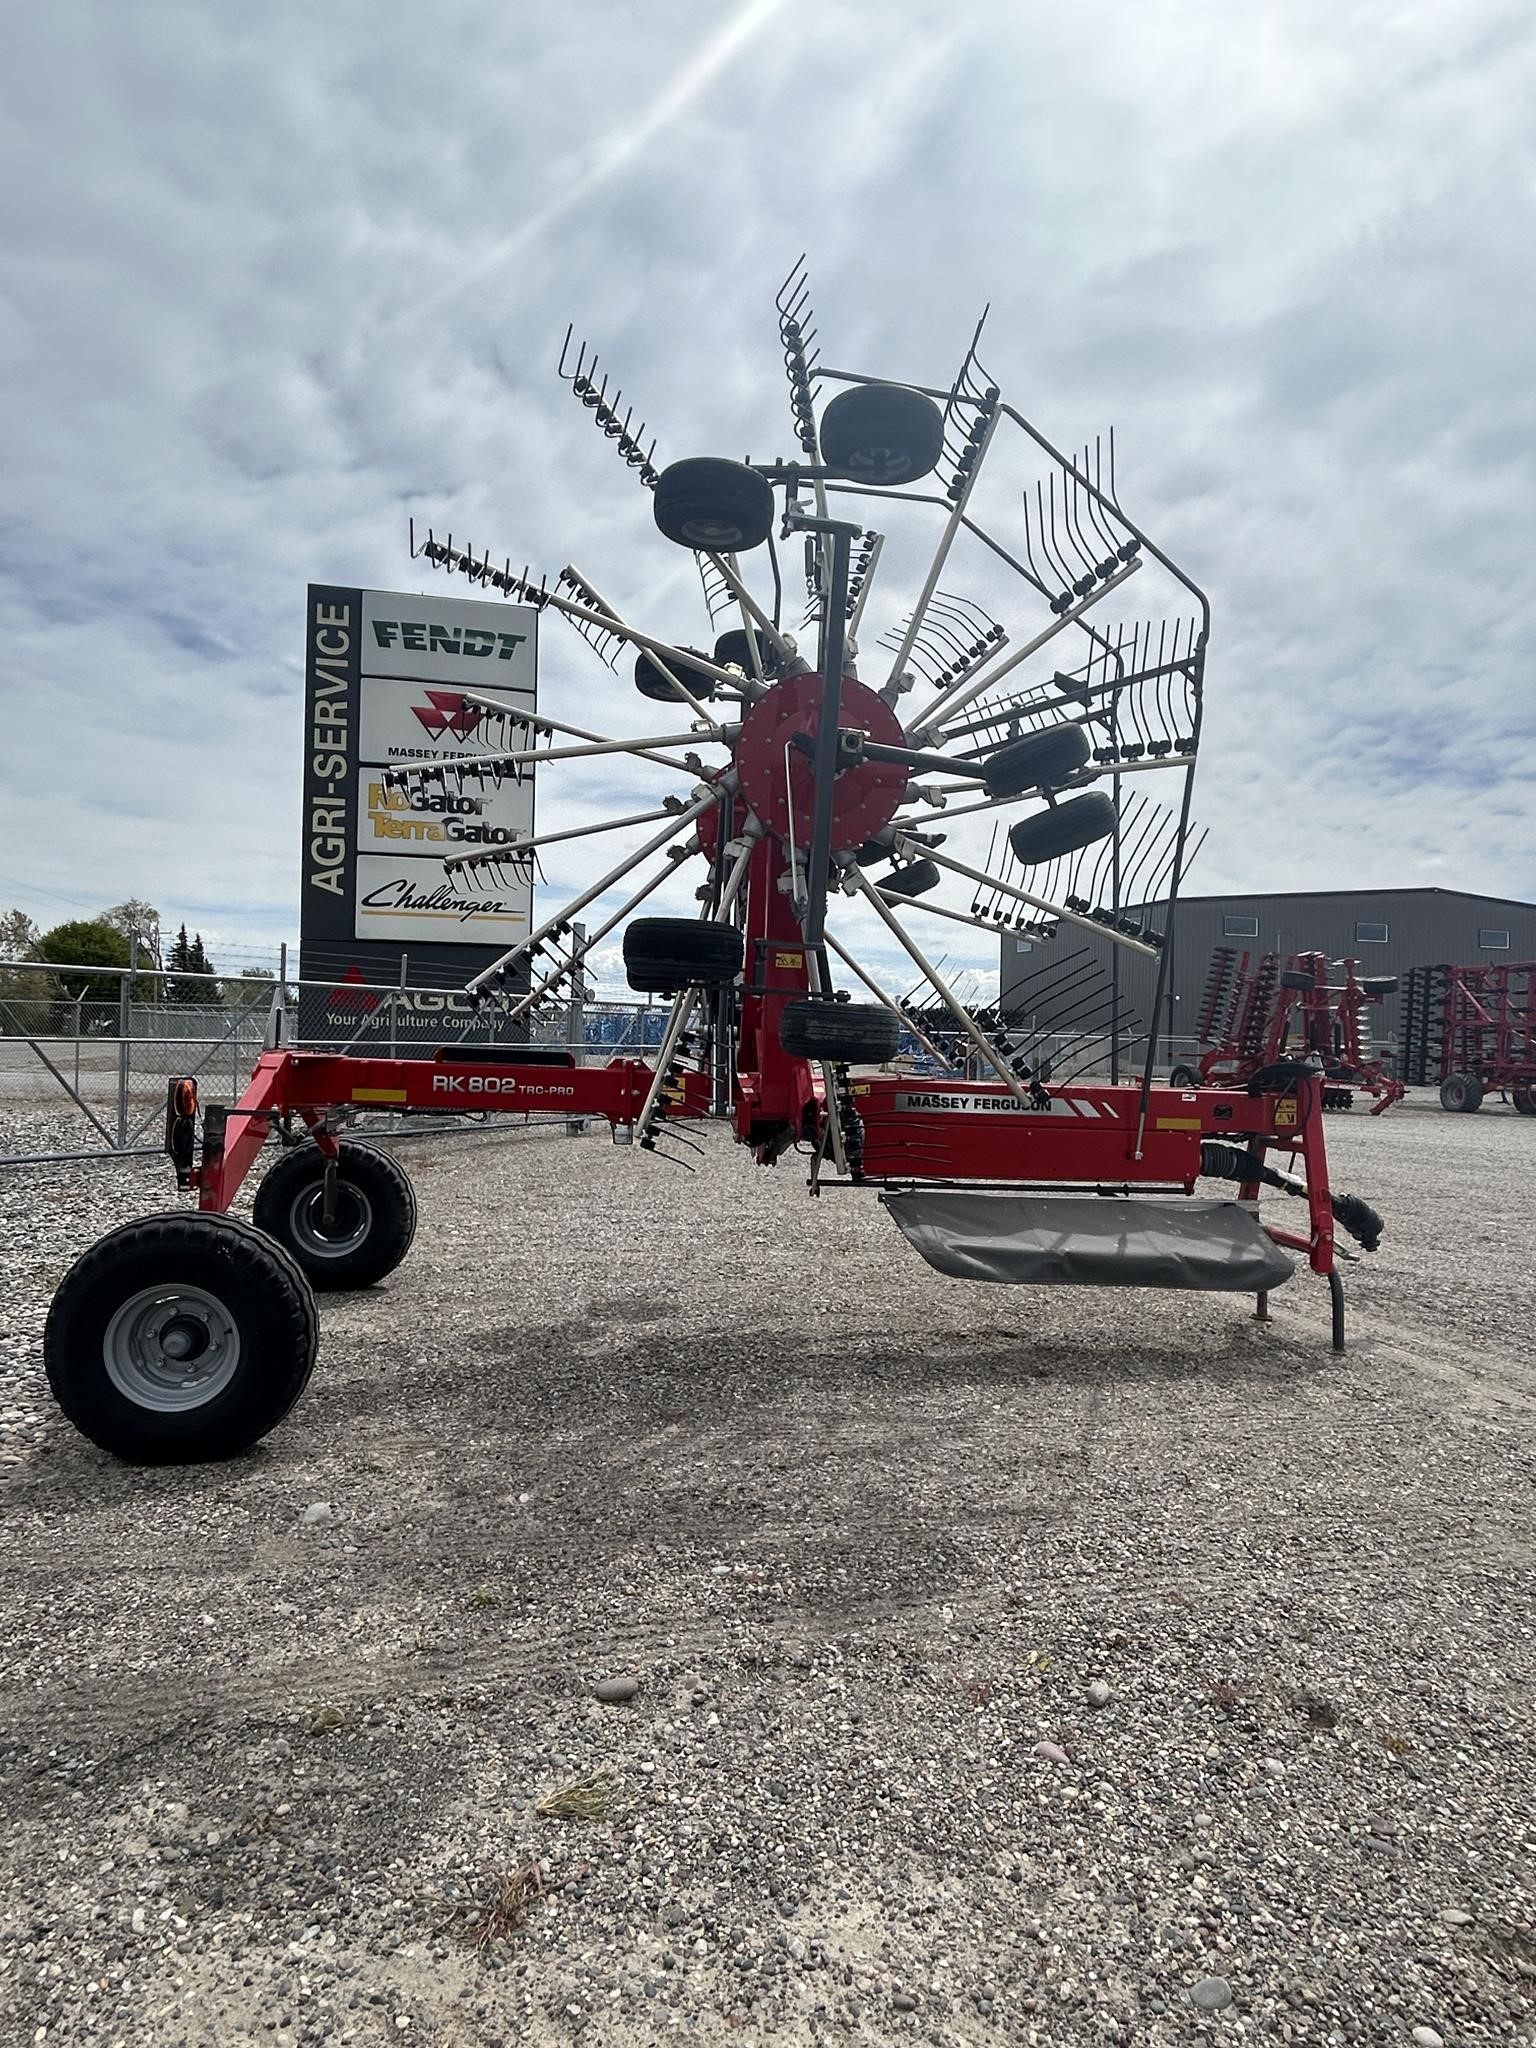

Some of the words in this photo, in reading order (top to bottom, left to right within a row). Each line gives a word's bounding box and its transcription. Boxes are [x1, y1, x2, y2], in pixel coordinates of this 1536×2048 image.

[371, 620, 527, 661] FENDT
[310, 603, 350, 896] AGRI-SERVICE
[387, 747, 439, 759] MASSEY
[368, 783, 489, 815] RoGator
[368, 811, 523, 845] TerraGator
[361, 879, 525, 922] Challenger
[326, 1012, 358, 1026] Your
[361, 1013, 439, 1030] Agriulture
[432, 1075, 465, 1092] RK
[468, 1076, 516, 1093] 802
[518, 1085, 575, 1096] TRC-PRO
[907, 1096, 971, 1109] MASSEY
